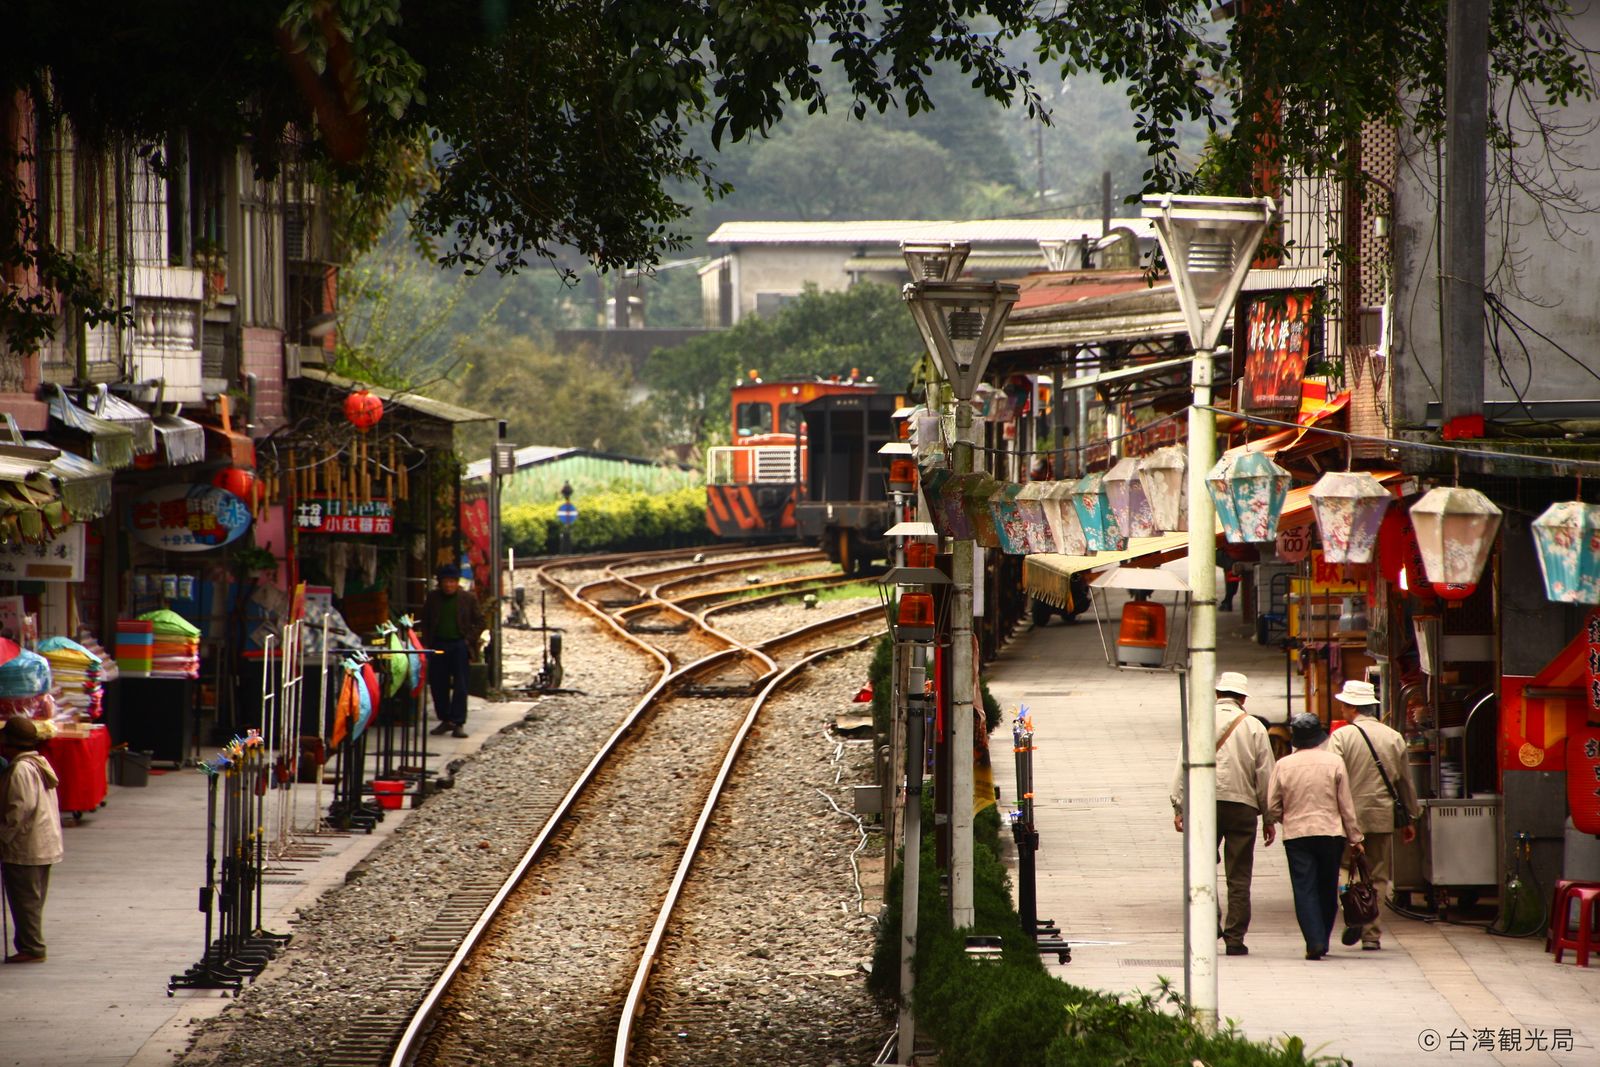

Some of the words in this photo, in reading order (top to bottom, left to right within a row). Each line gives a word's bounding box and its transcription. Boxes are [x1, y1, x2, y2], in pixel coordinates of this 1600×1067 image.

[131, 499, 187, 529] 芒果
[217, 496, 248, 528] 冰
[297, 503, 322, 515] 十分
[325, 517, 391, 532] 小紅番茄
[1284, 538, 1303, 552] 100
